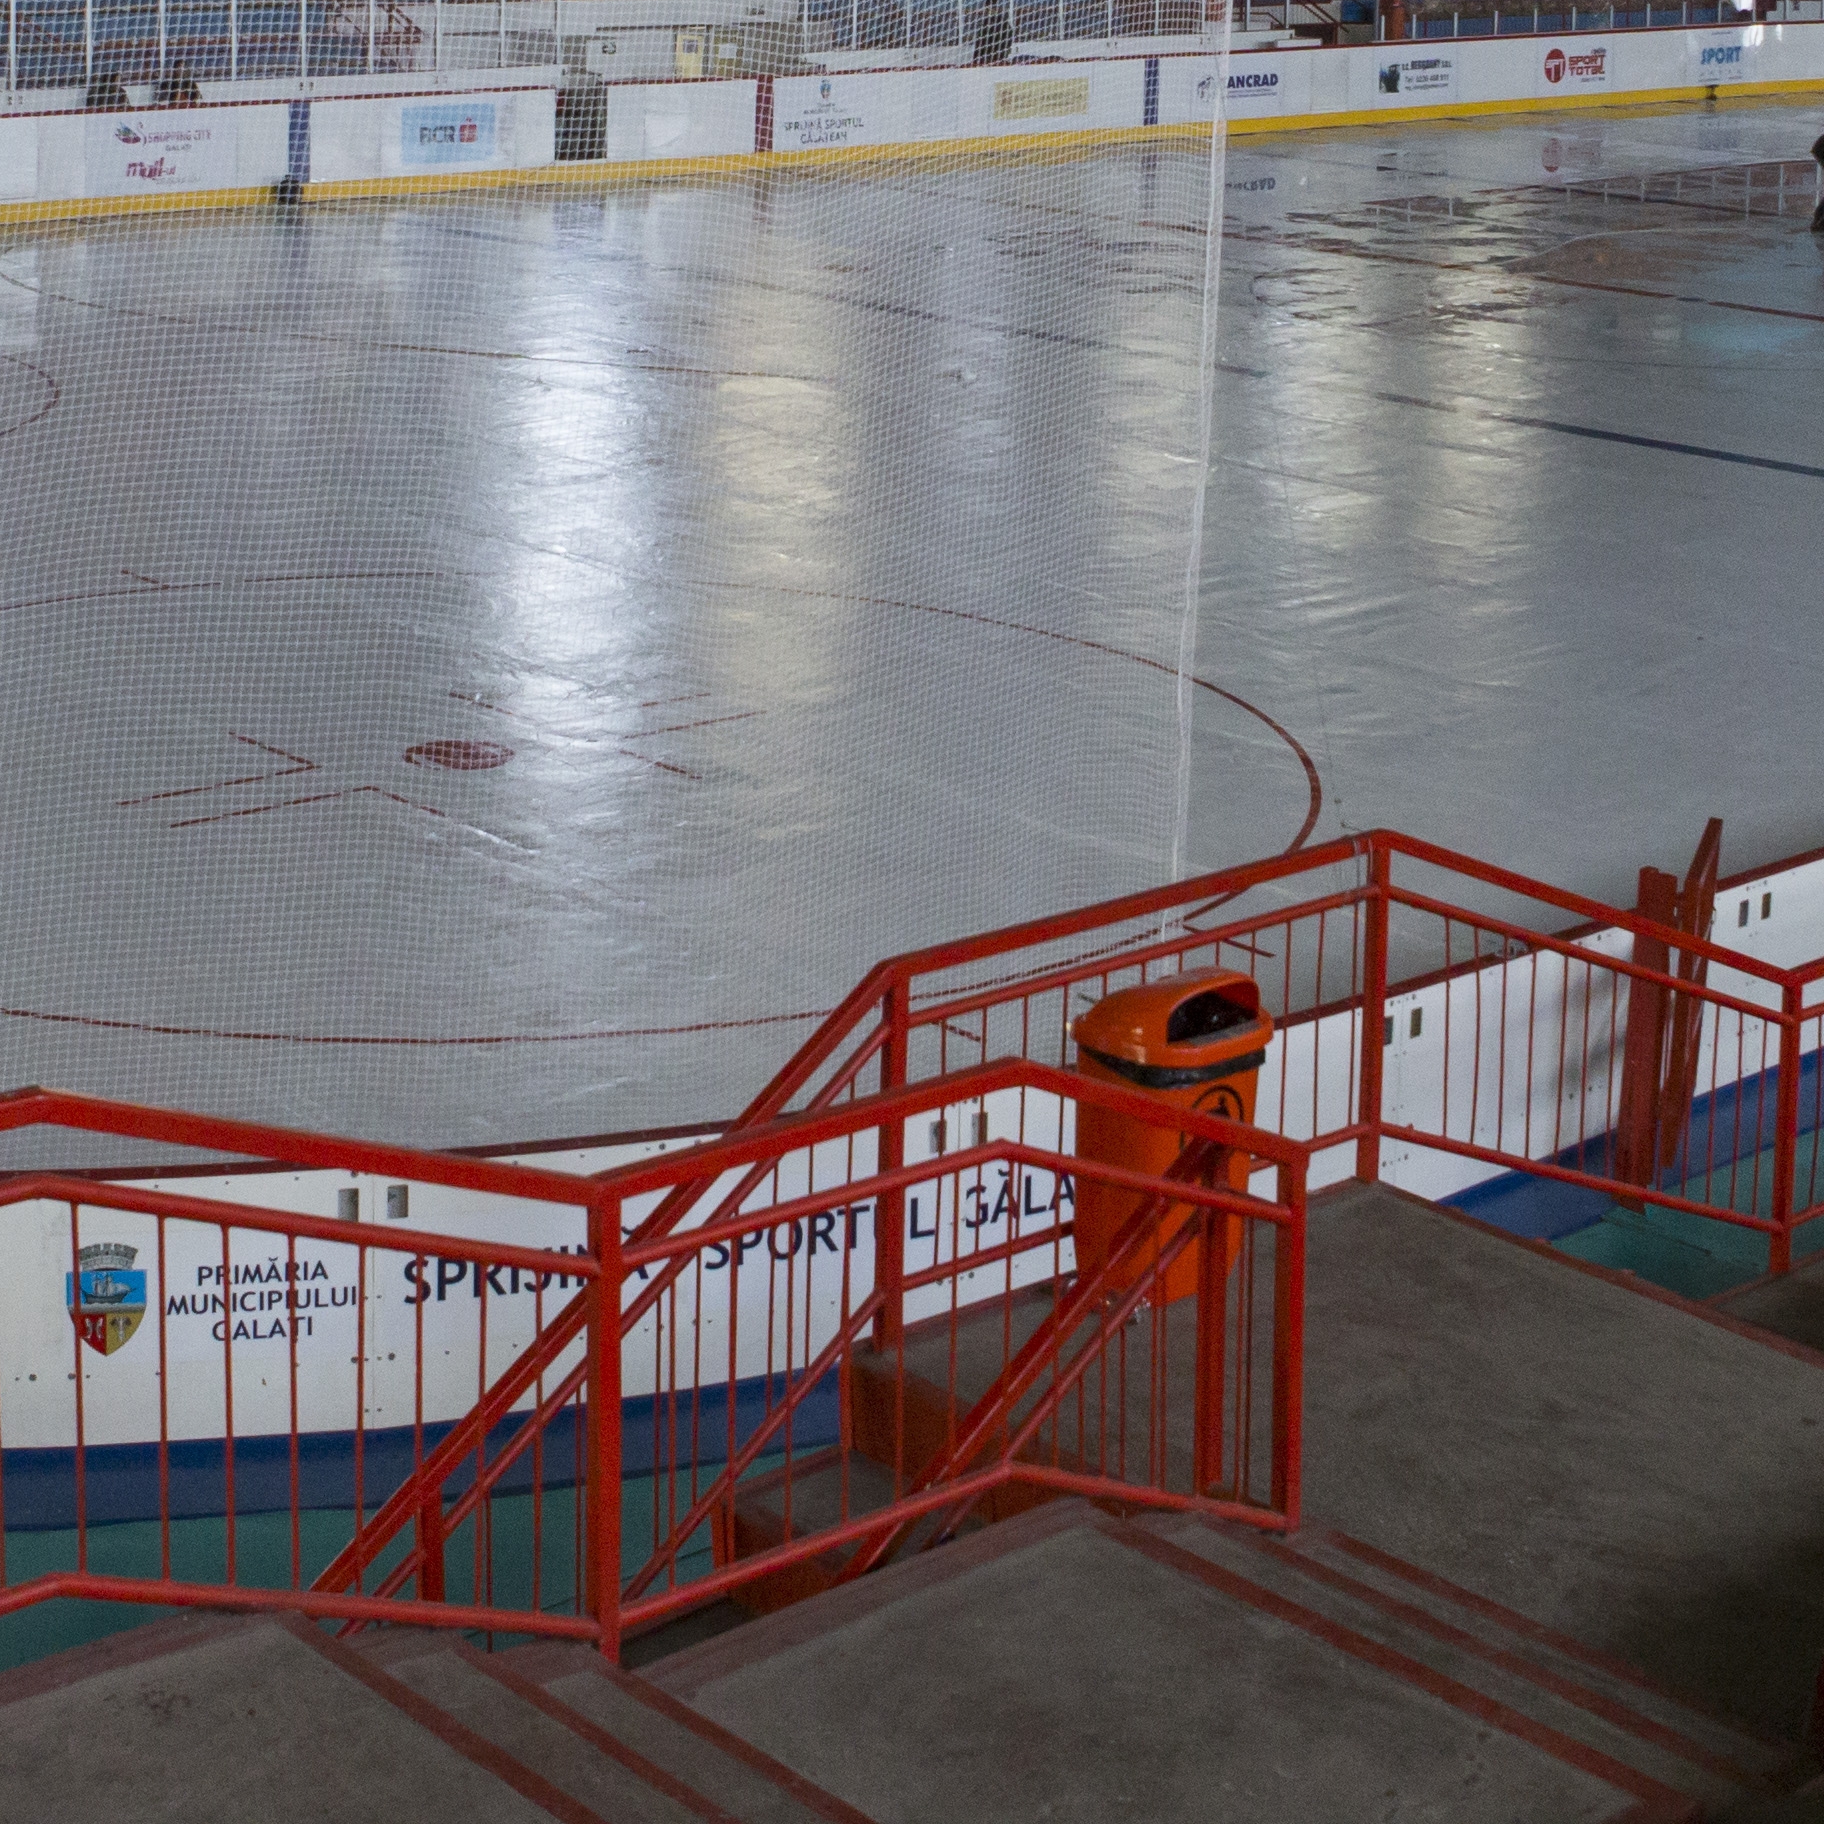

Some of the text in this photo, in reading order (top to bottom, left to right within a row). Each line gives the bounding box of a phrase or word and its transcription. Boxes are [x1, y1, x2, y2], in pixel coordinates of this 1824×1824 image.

[1569, 55, 1605, 66] SPORT
[1569, 66, 1605, 76] TOTAL
[1227, 74, 1279, 88] ANCRAD
[704, 1196, 936, 1270] SPORTL
[166, 1286, 357, 1315] MUNICIPIULUI
